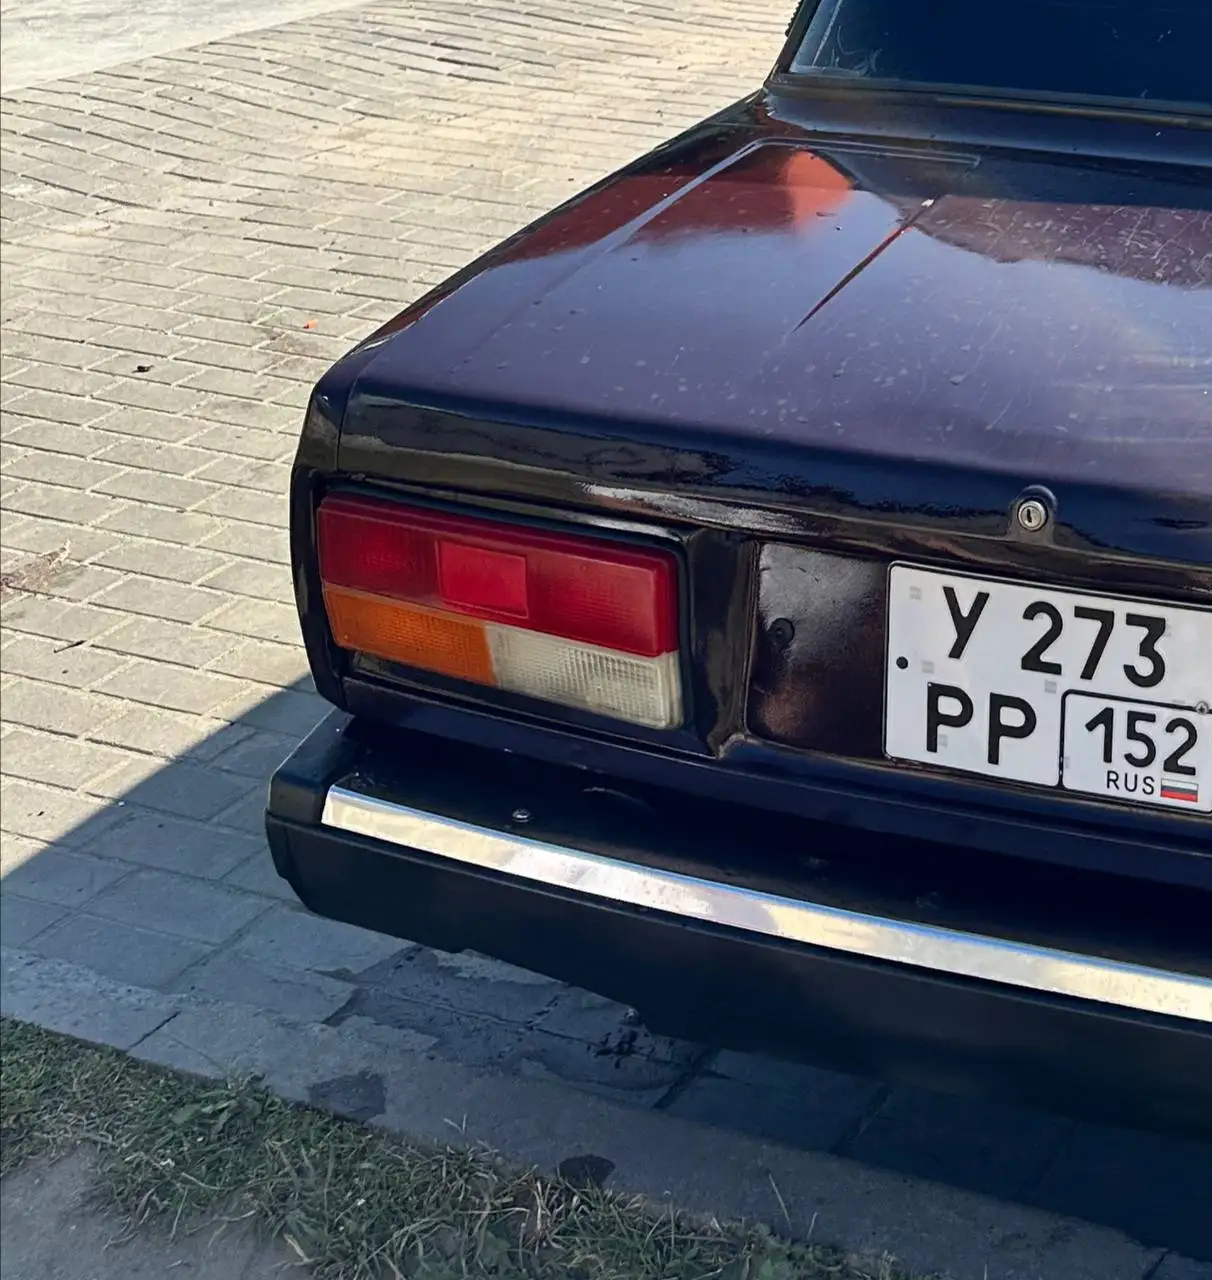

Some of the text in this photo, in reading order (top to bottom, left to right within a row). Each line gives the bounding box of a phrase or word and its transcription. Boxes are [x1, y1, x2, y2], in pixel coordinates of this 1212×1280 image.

[942, 585, 1167, 688] У 273
[925, 681, 1037, 766] РР
[1084, 706, 1198, 776] 152
[1105, 770, 1156, 796] RUS
